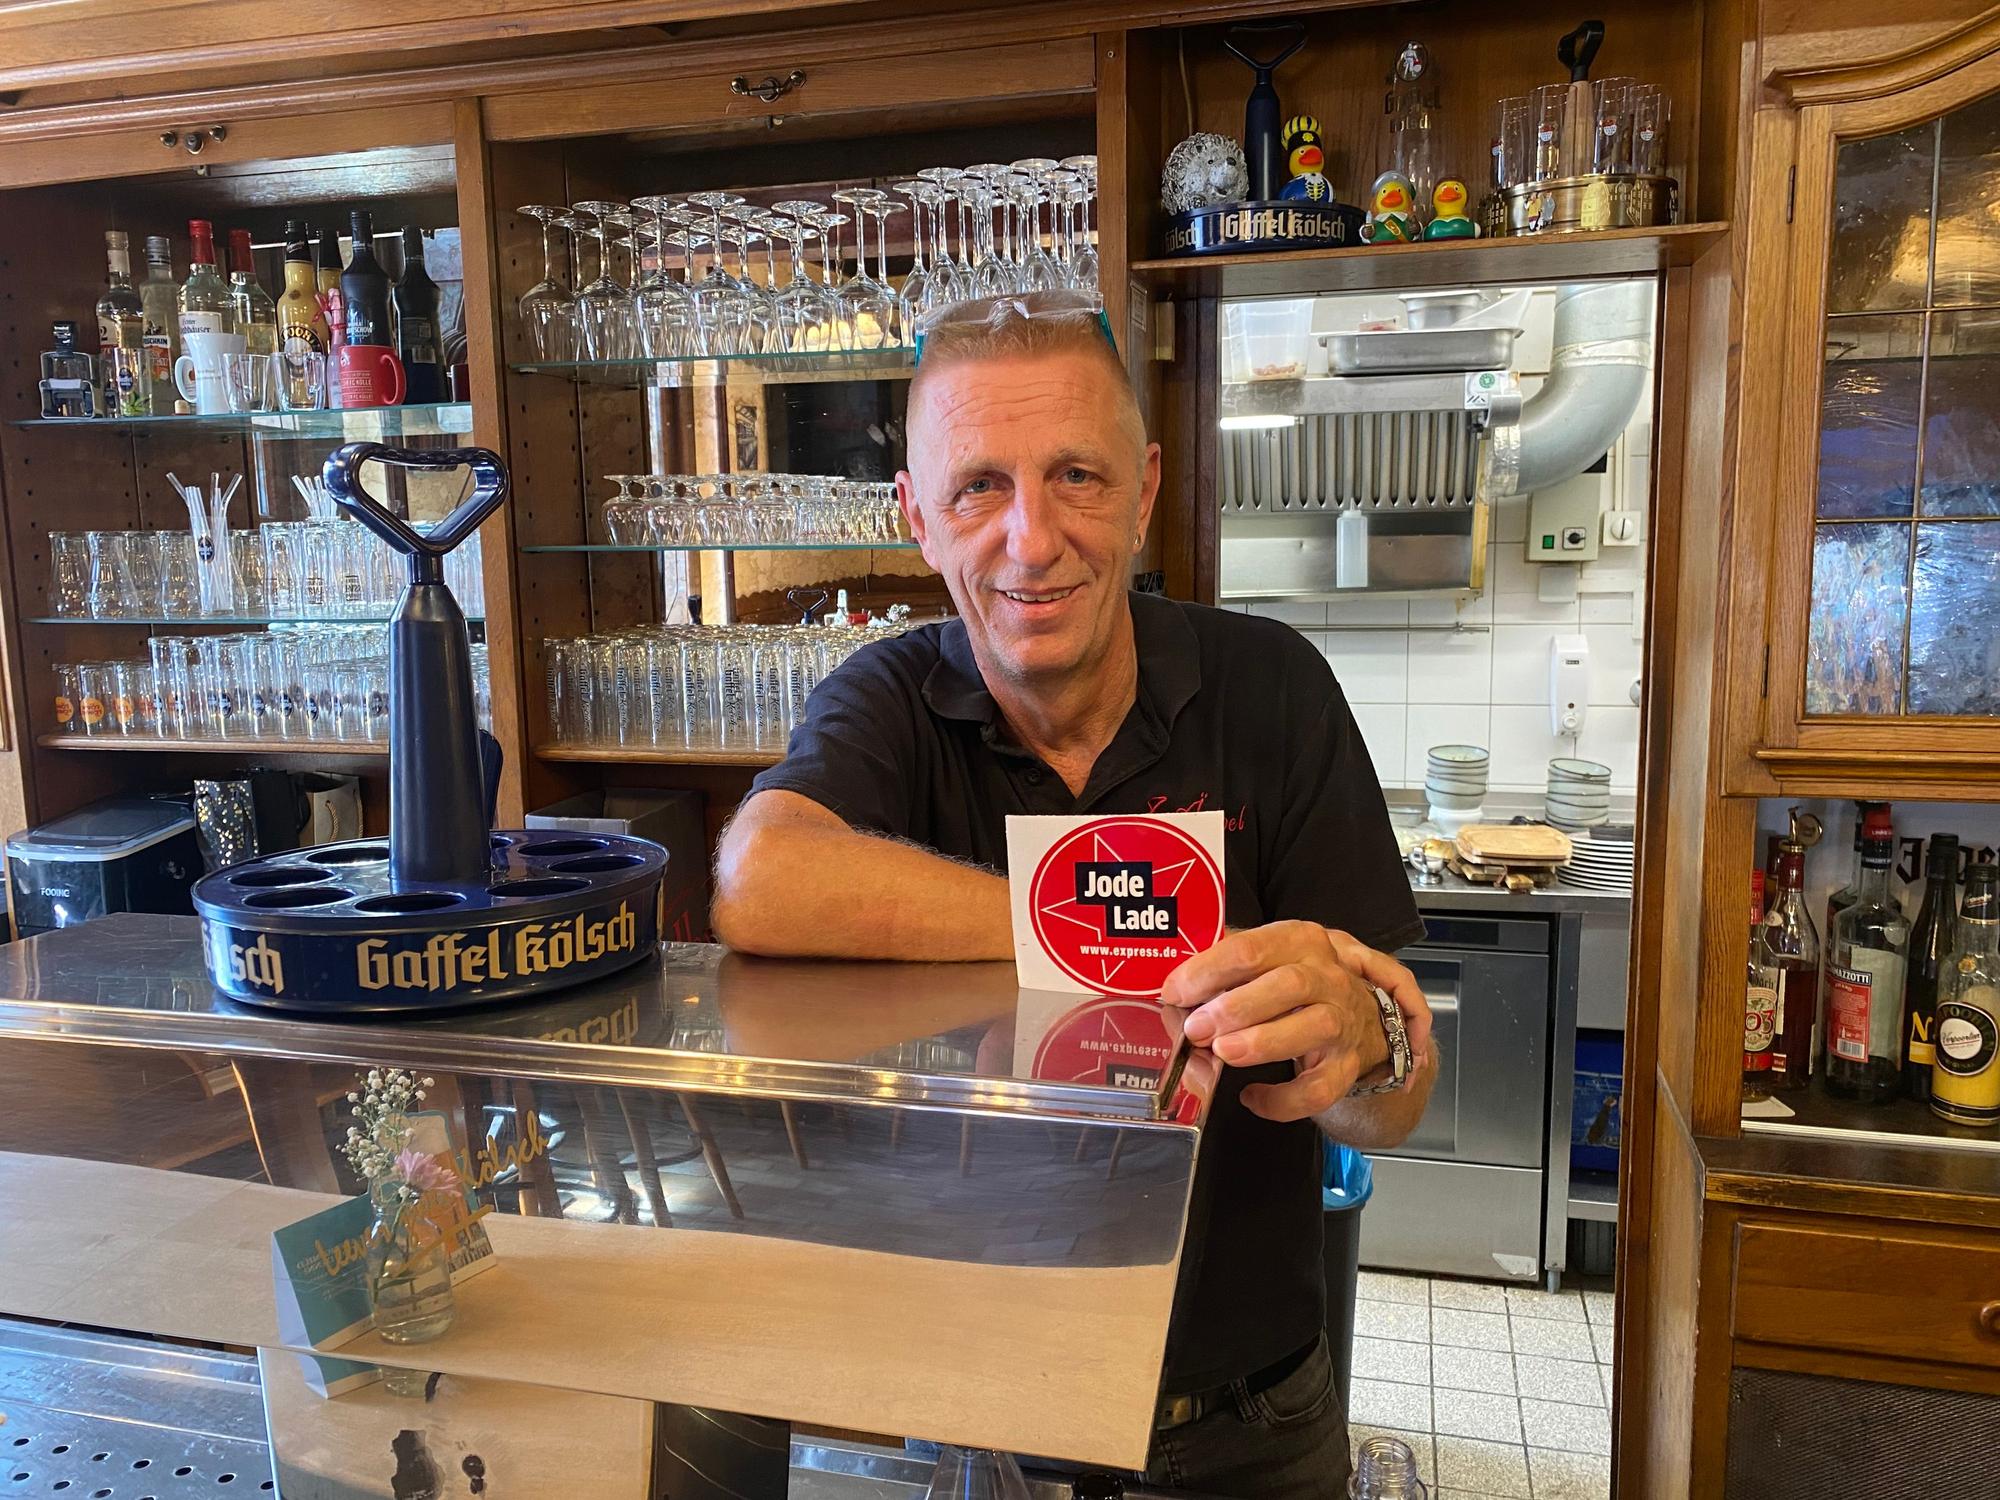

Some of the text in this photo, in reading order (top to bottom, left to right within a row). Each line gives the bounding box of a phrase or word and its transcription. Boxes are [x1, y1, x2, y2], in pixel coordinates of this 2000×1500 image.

[1225, 209, 1346, 243] Gaffel Kölsch
[1084, 869, 1144, 898] Jode
[1113, 904, 1170, 931] Lade
[356, 928, 508, 993] Gaffel
[515, 899, 636, 977] Kölsch
[1080, 945, 1178, 959] www.express.de
[1745, 1010, 1776, 1035] 03
